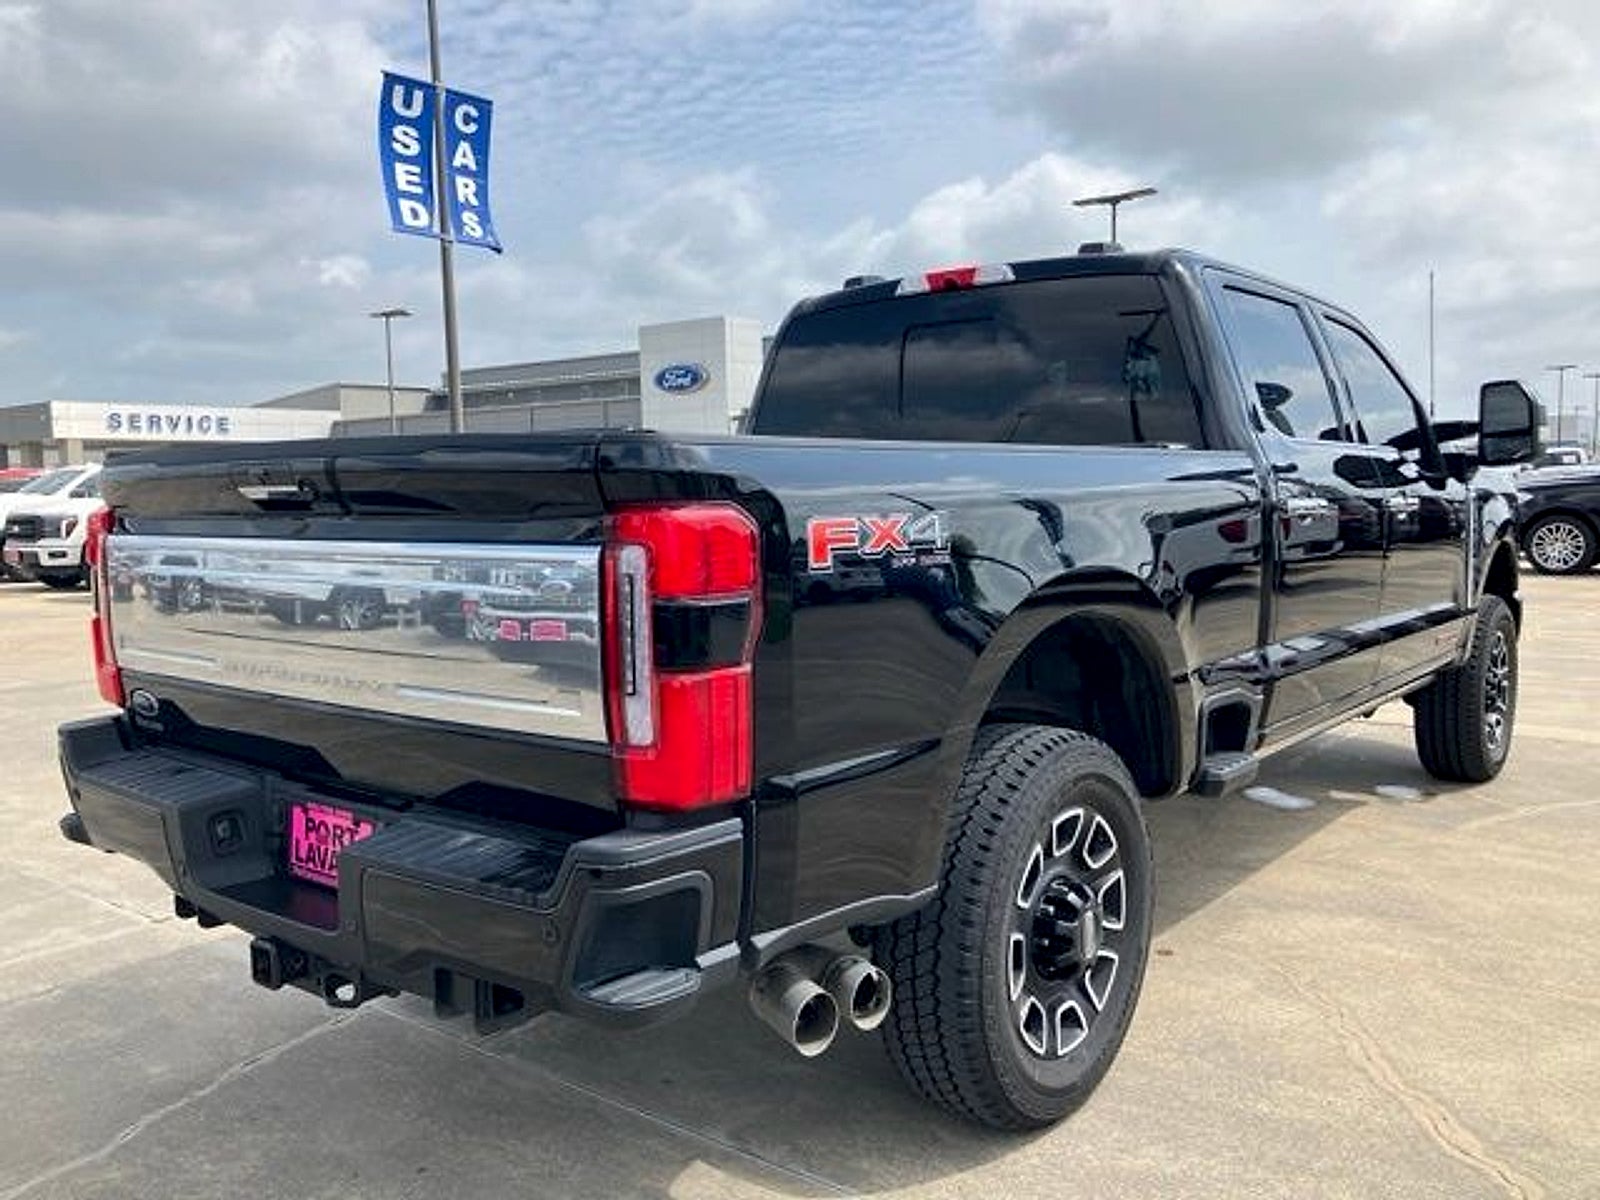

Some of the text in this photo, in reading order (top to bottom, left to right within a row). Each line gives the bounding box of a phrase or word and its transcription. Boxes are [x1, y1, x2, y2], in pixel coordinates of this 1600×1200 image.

[391, 84, 430, 228] USED
[452, 104, 484, 239] CARS
[661, 369, 693, 390] Ford
[107, 412, 230, 434] SERVICE
[808, 511, 950, 573] FX4
[304, 817, 359, 849] PORT
